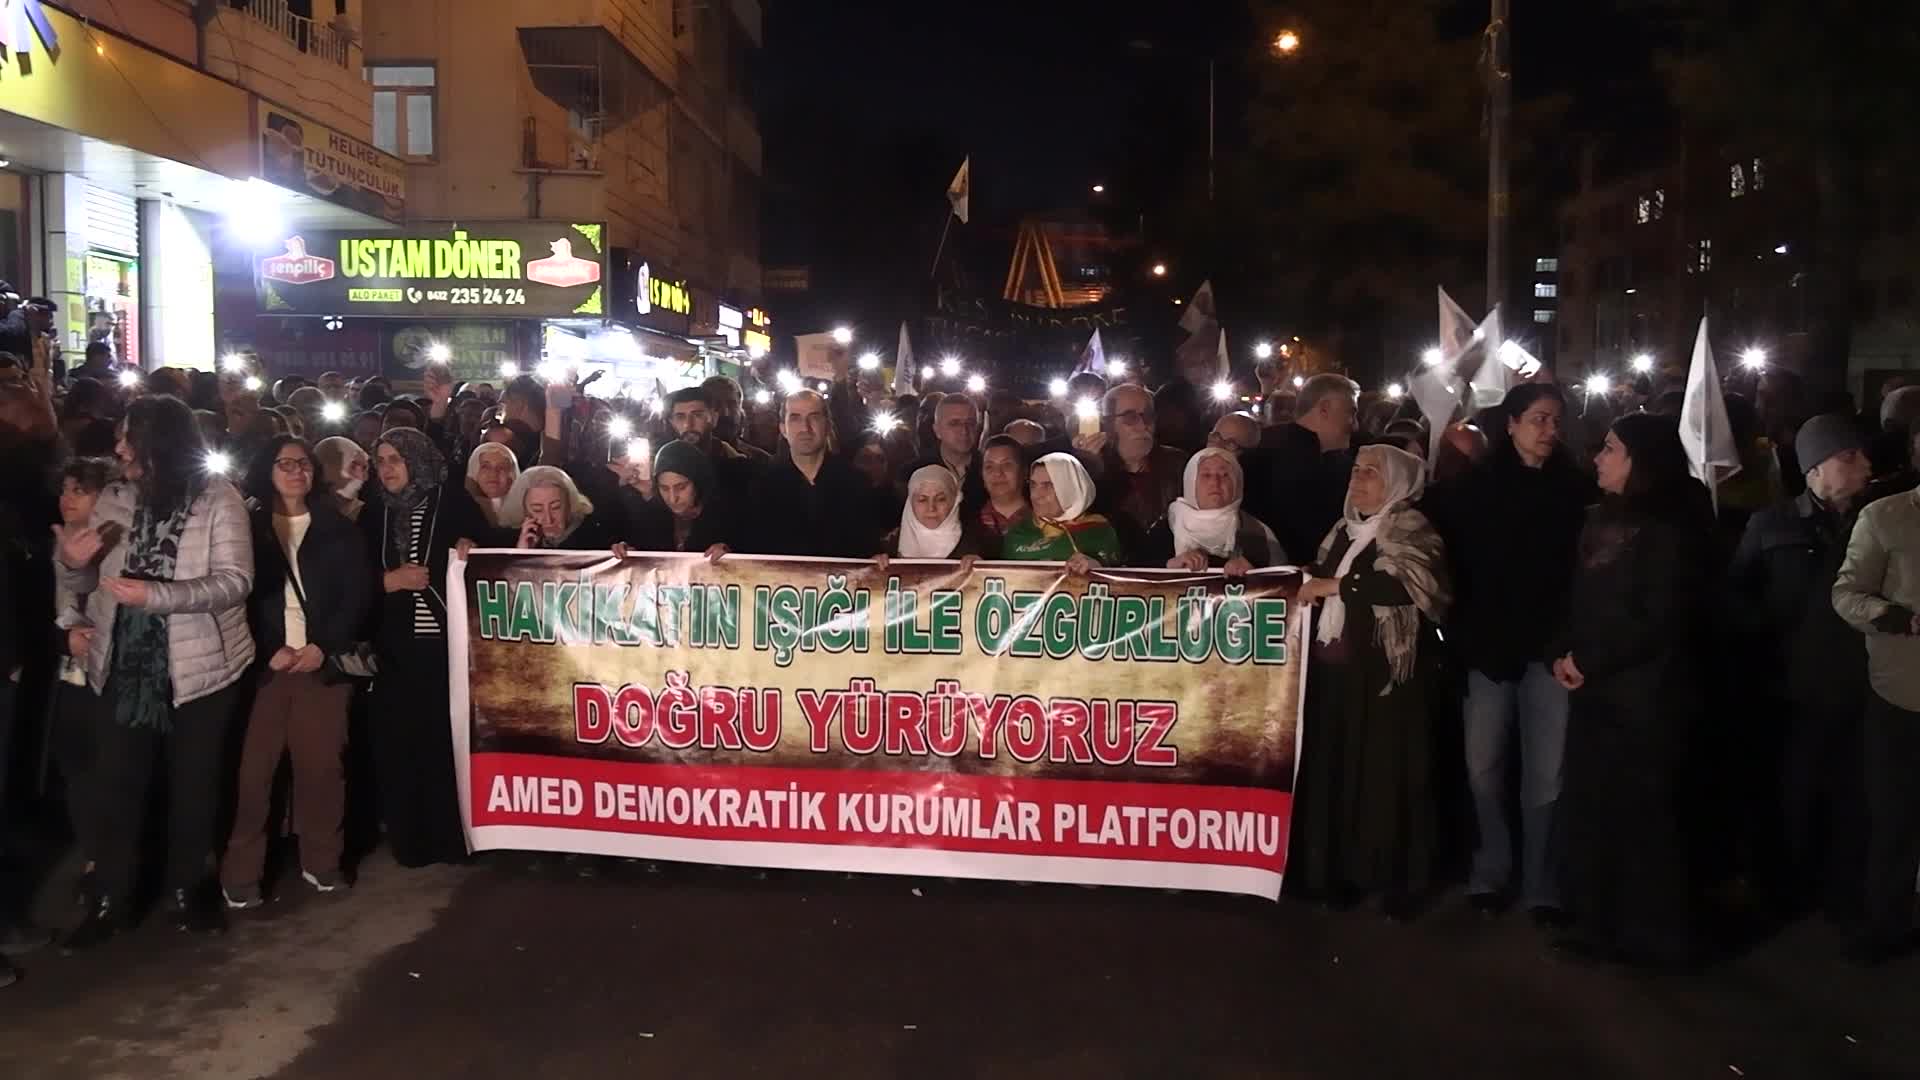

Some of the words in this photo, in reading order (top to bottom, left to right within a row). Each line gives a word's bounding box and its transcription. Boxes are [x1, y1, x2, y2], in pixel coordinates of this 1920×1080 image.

[340, 239, 431, 279] USTAM
[434, 230, 521, 280] DÖNER
[450, 288, 480, 304] 235
[482, 288, 503, 305] 24
[505, 288, 526, 305] 24
[475, 573, 741, 650] HAKİKATIN
[753, 574, 871, 667] IŞIĞI
[884, 576, 963, 655] İLE
[975, 576, 1289, 664] ÖZGÜRLÜĞE
[572, 669, 783, 752] DOĞRU
[795, 677, 1179, 768] YÜRÜYORUZ
[487, 774, 584, 817] AMED
[594, 781, 826, 832] DEMOKRATİK
[837, 793, 1042, 842] KURUMLAR
[1053, 803, 1280, 856] PLATFORMU
